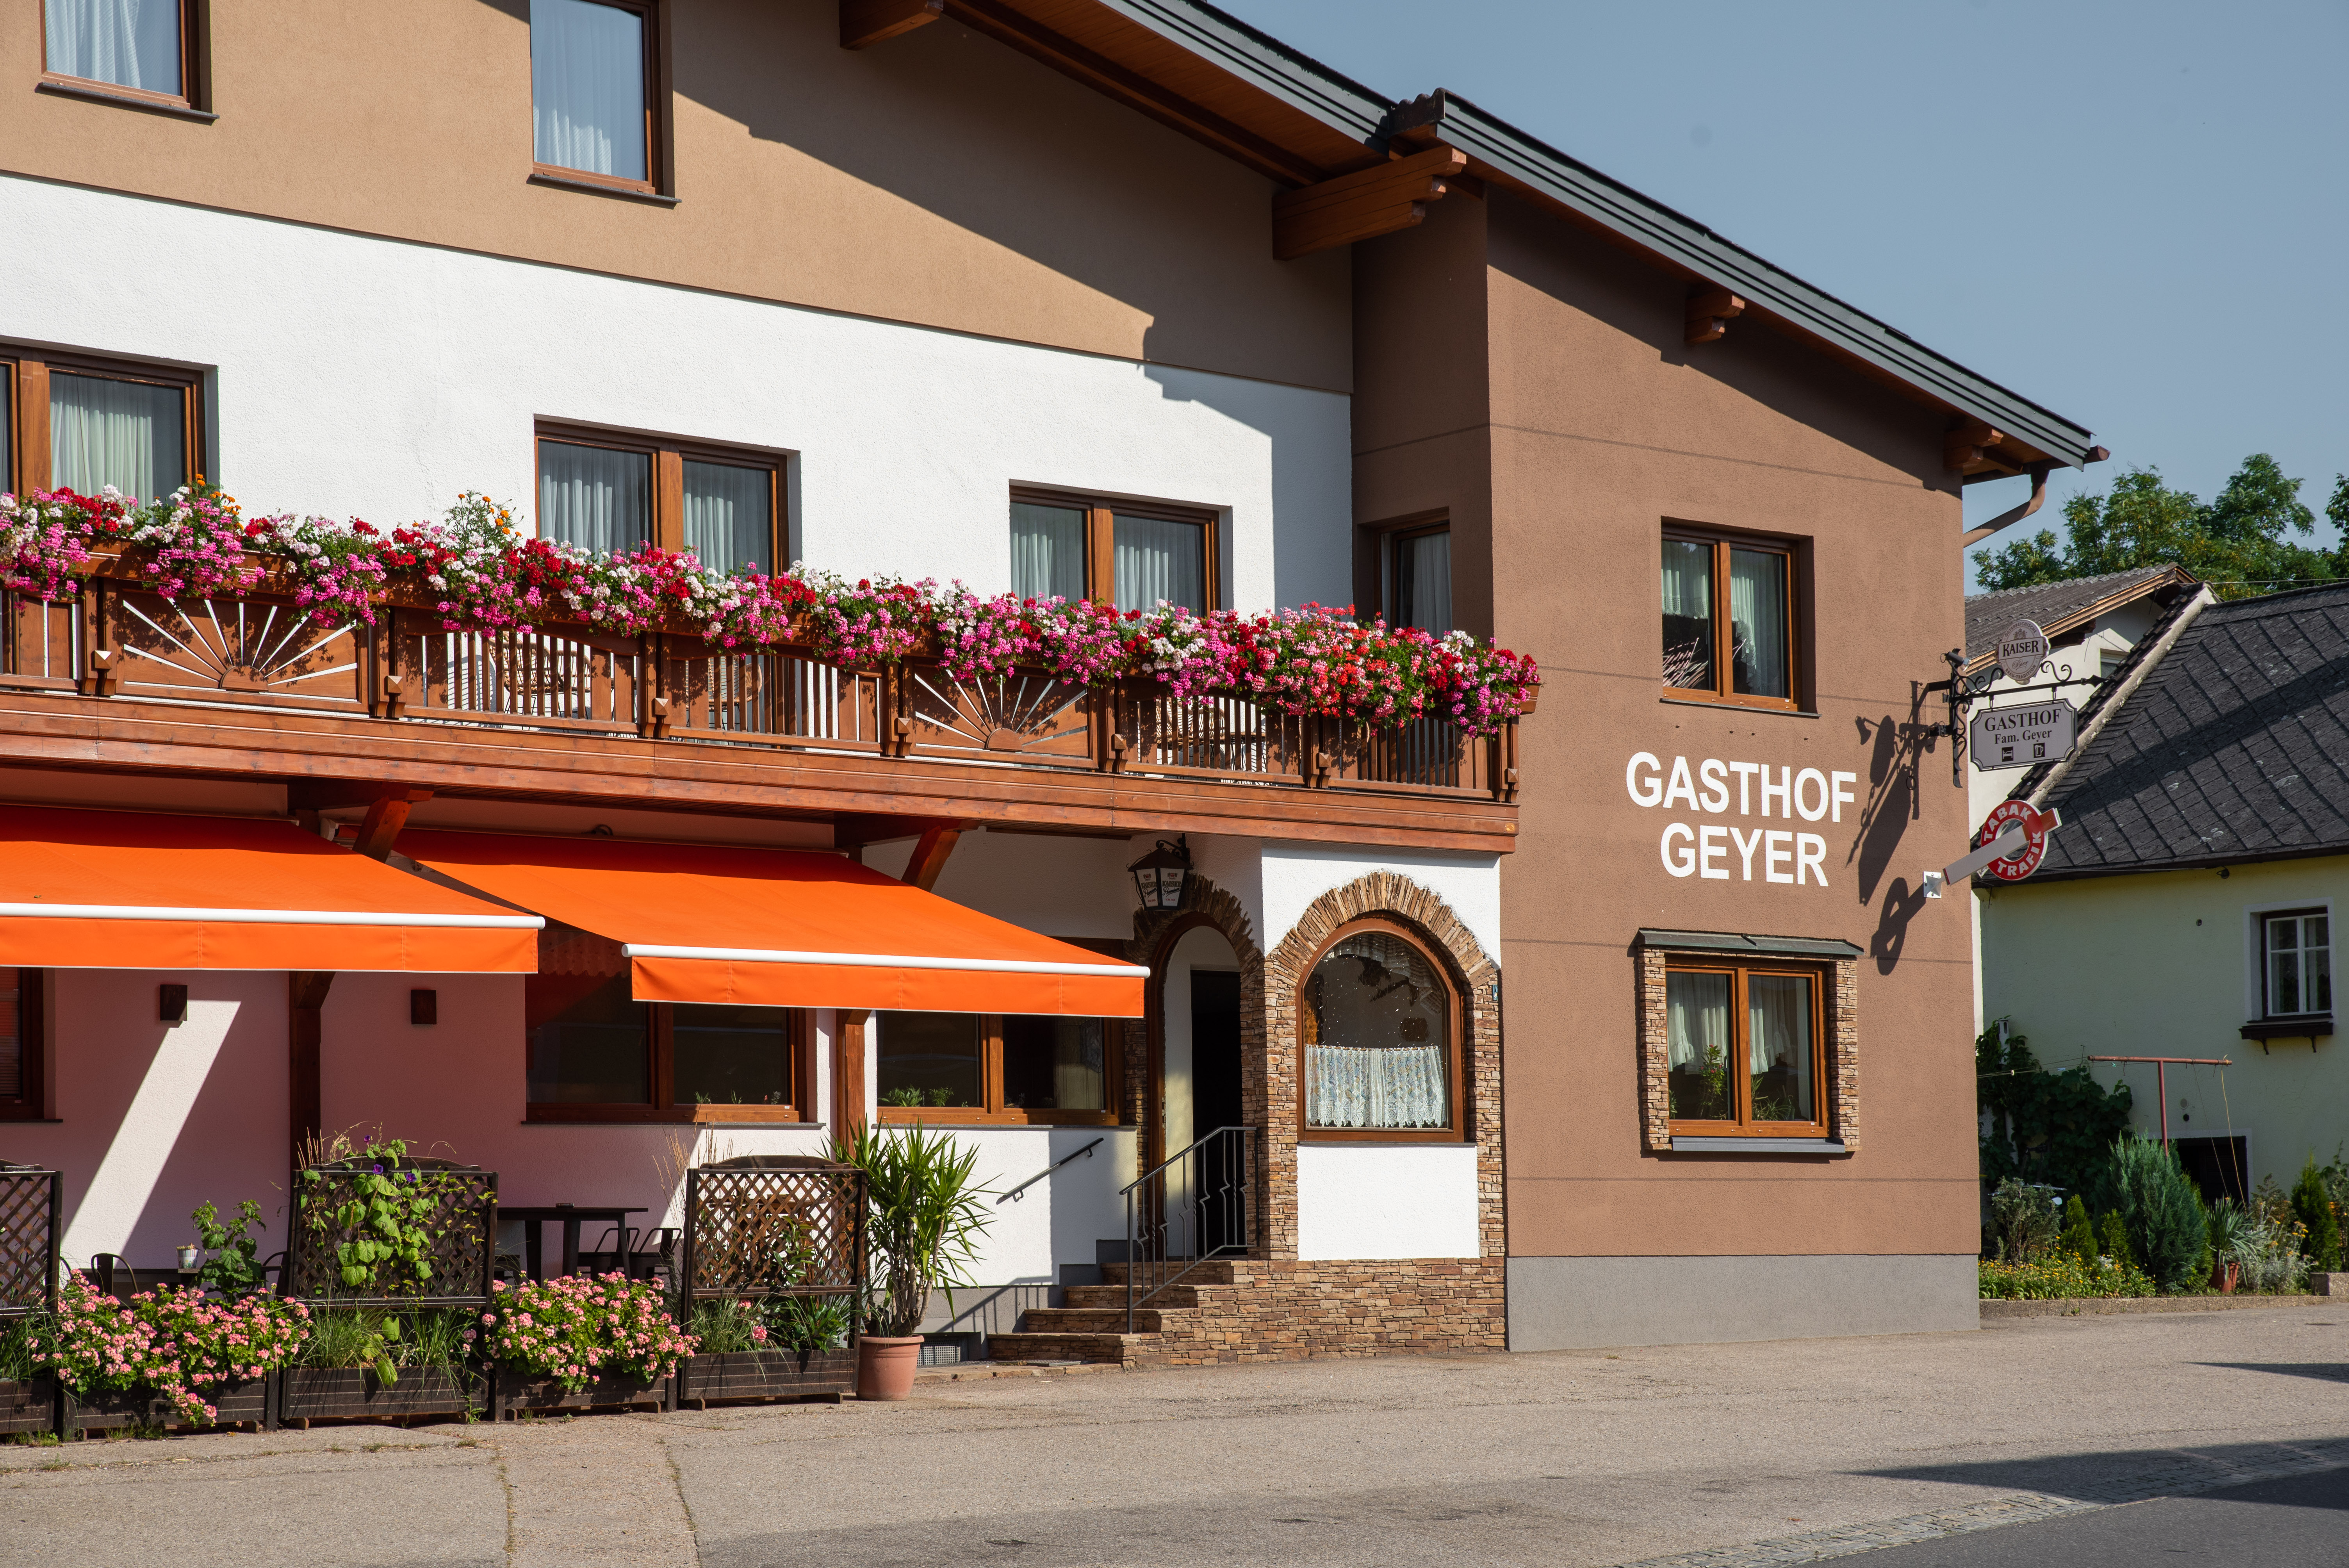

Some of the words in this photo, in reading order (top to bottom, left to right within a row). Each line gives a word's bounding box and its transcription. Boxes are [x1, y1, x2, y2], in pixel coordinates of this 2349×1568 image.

[2003, 640, 2039, 657] KAISER
[2012, 659, 2028, 670] Bier
[1985, 709, 2061, 731] GASTHOF
[1994, 734, 2019, 744] Fam.
[2023, 730, 2052, 742] Geyer
[1626, 752, 1856, 823] GASTHOF
[1984, 804, 2032, 841] TABAK
[1661, 823, 1829, 887] GEYER
[1997, 831, 2041, 876] TRAFIK
